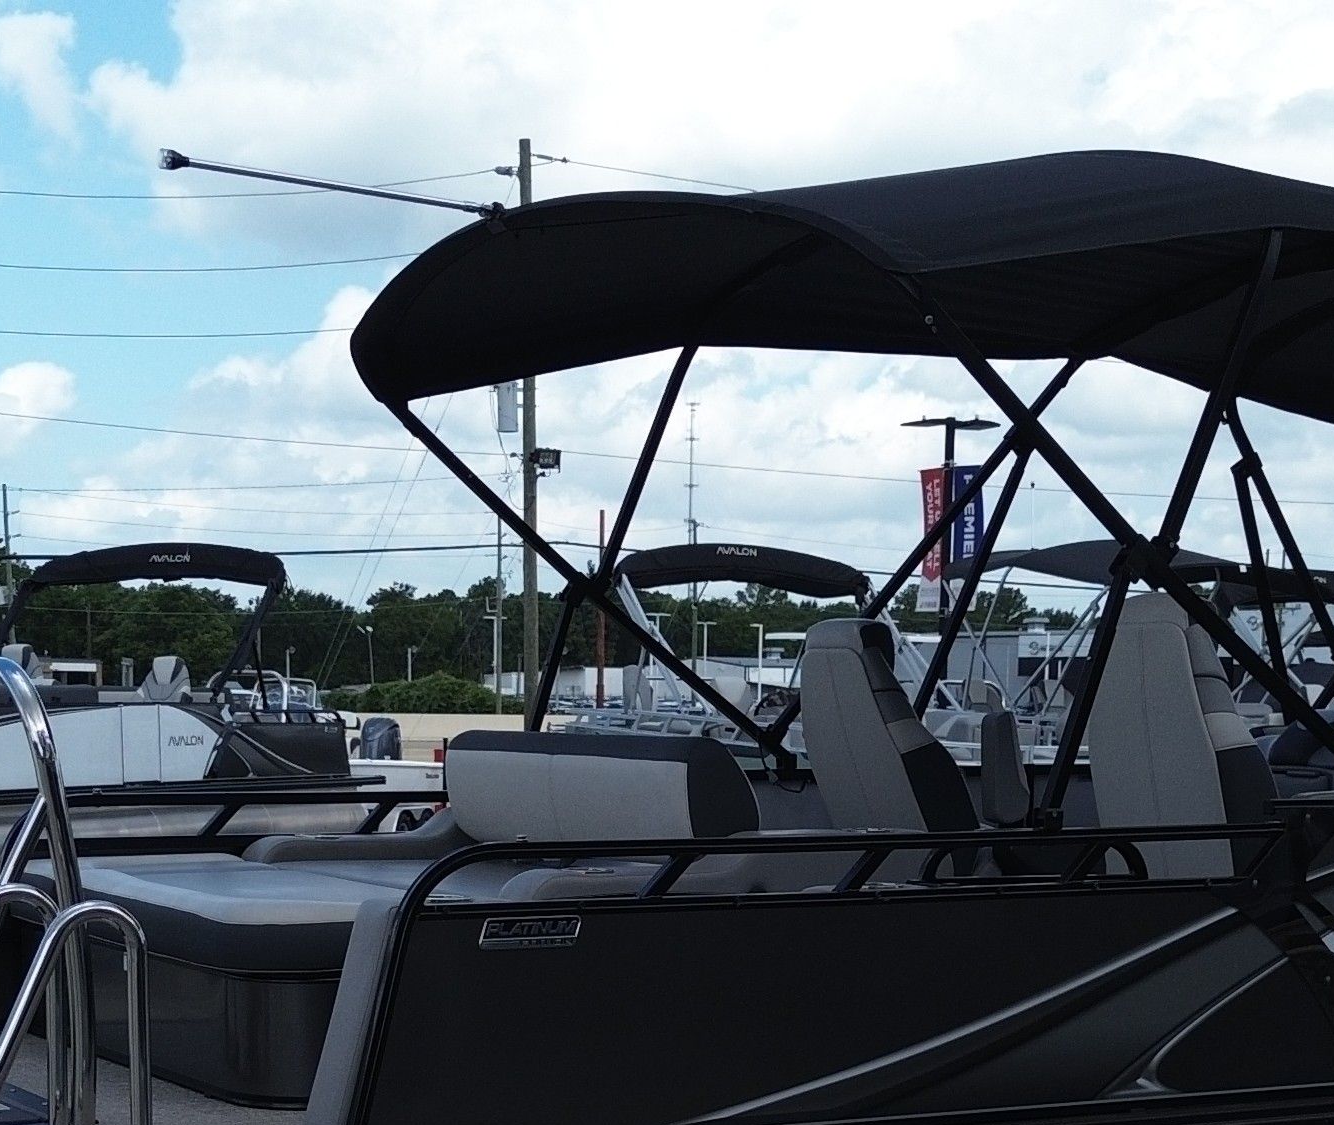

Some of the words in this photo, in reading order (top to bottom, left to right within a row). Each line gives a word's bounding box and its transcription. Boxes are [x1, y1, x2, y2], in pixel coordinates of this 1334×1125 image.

[716, 546, 758, 557] AVALON
[148, 554, 191, 563] AVALON
[167, 735, 204, 747] AVALON
[485, 920, 578, 937] PLATINUM
